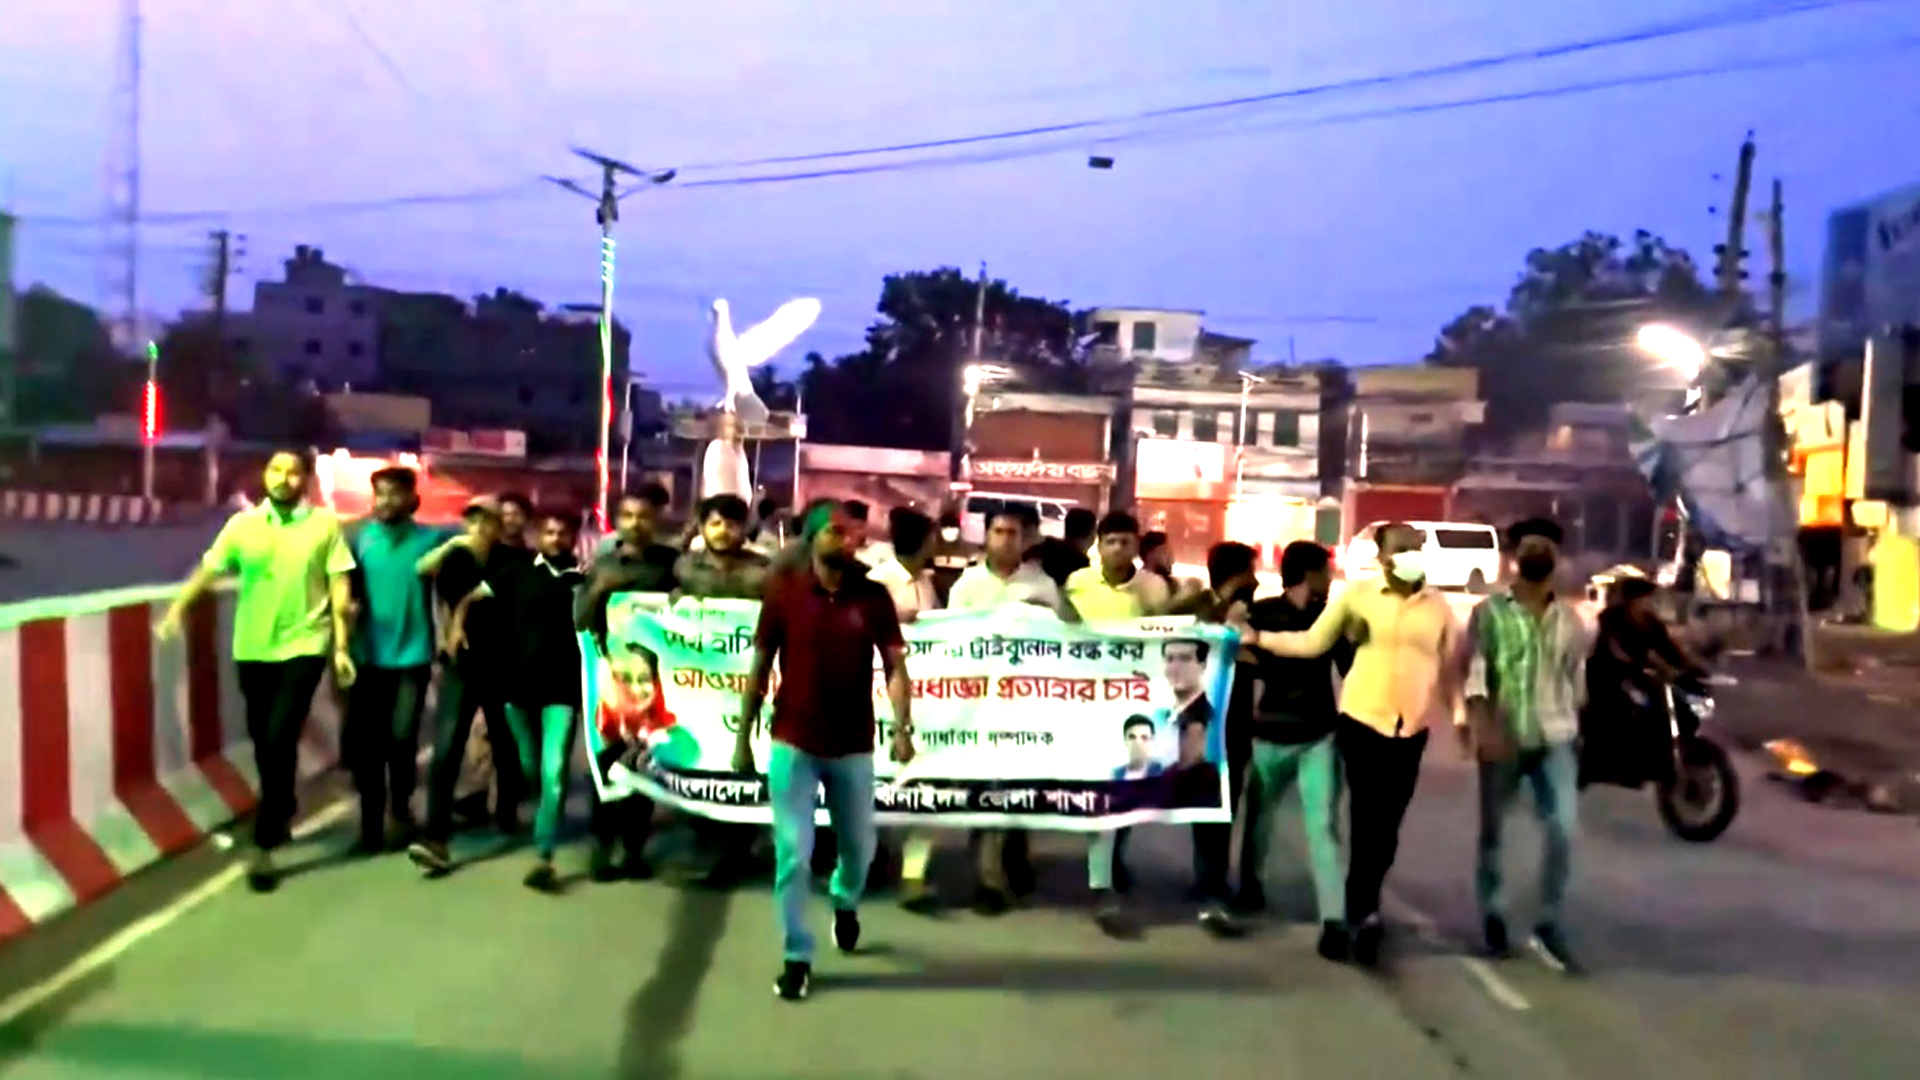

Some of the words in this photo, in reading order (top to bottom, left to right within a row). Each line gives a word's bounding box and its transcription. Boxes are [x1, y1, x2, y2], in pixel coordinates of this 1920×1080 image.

[1108, 640, 1145, 661] কর
[673, 666, 752, 694] আওয়া
[997, 674, 1096, 703] প্রত্যাহার
[1103, 670, 1151, 702] চাই
[663, 771, 763, 803] বাংলাদেশ
